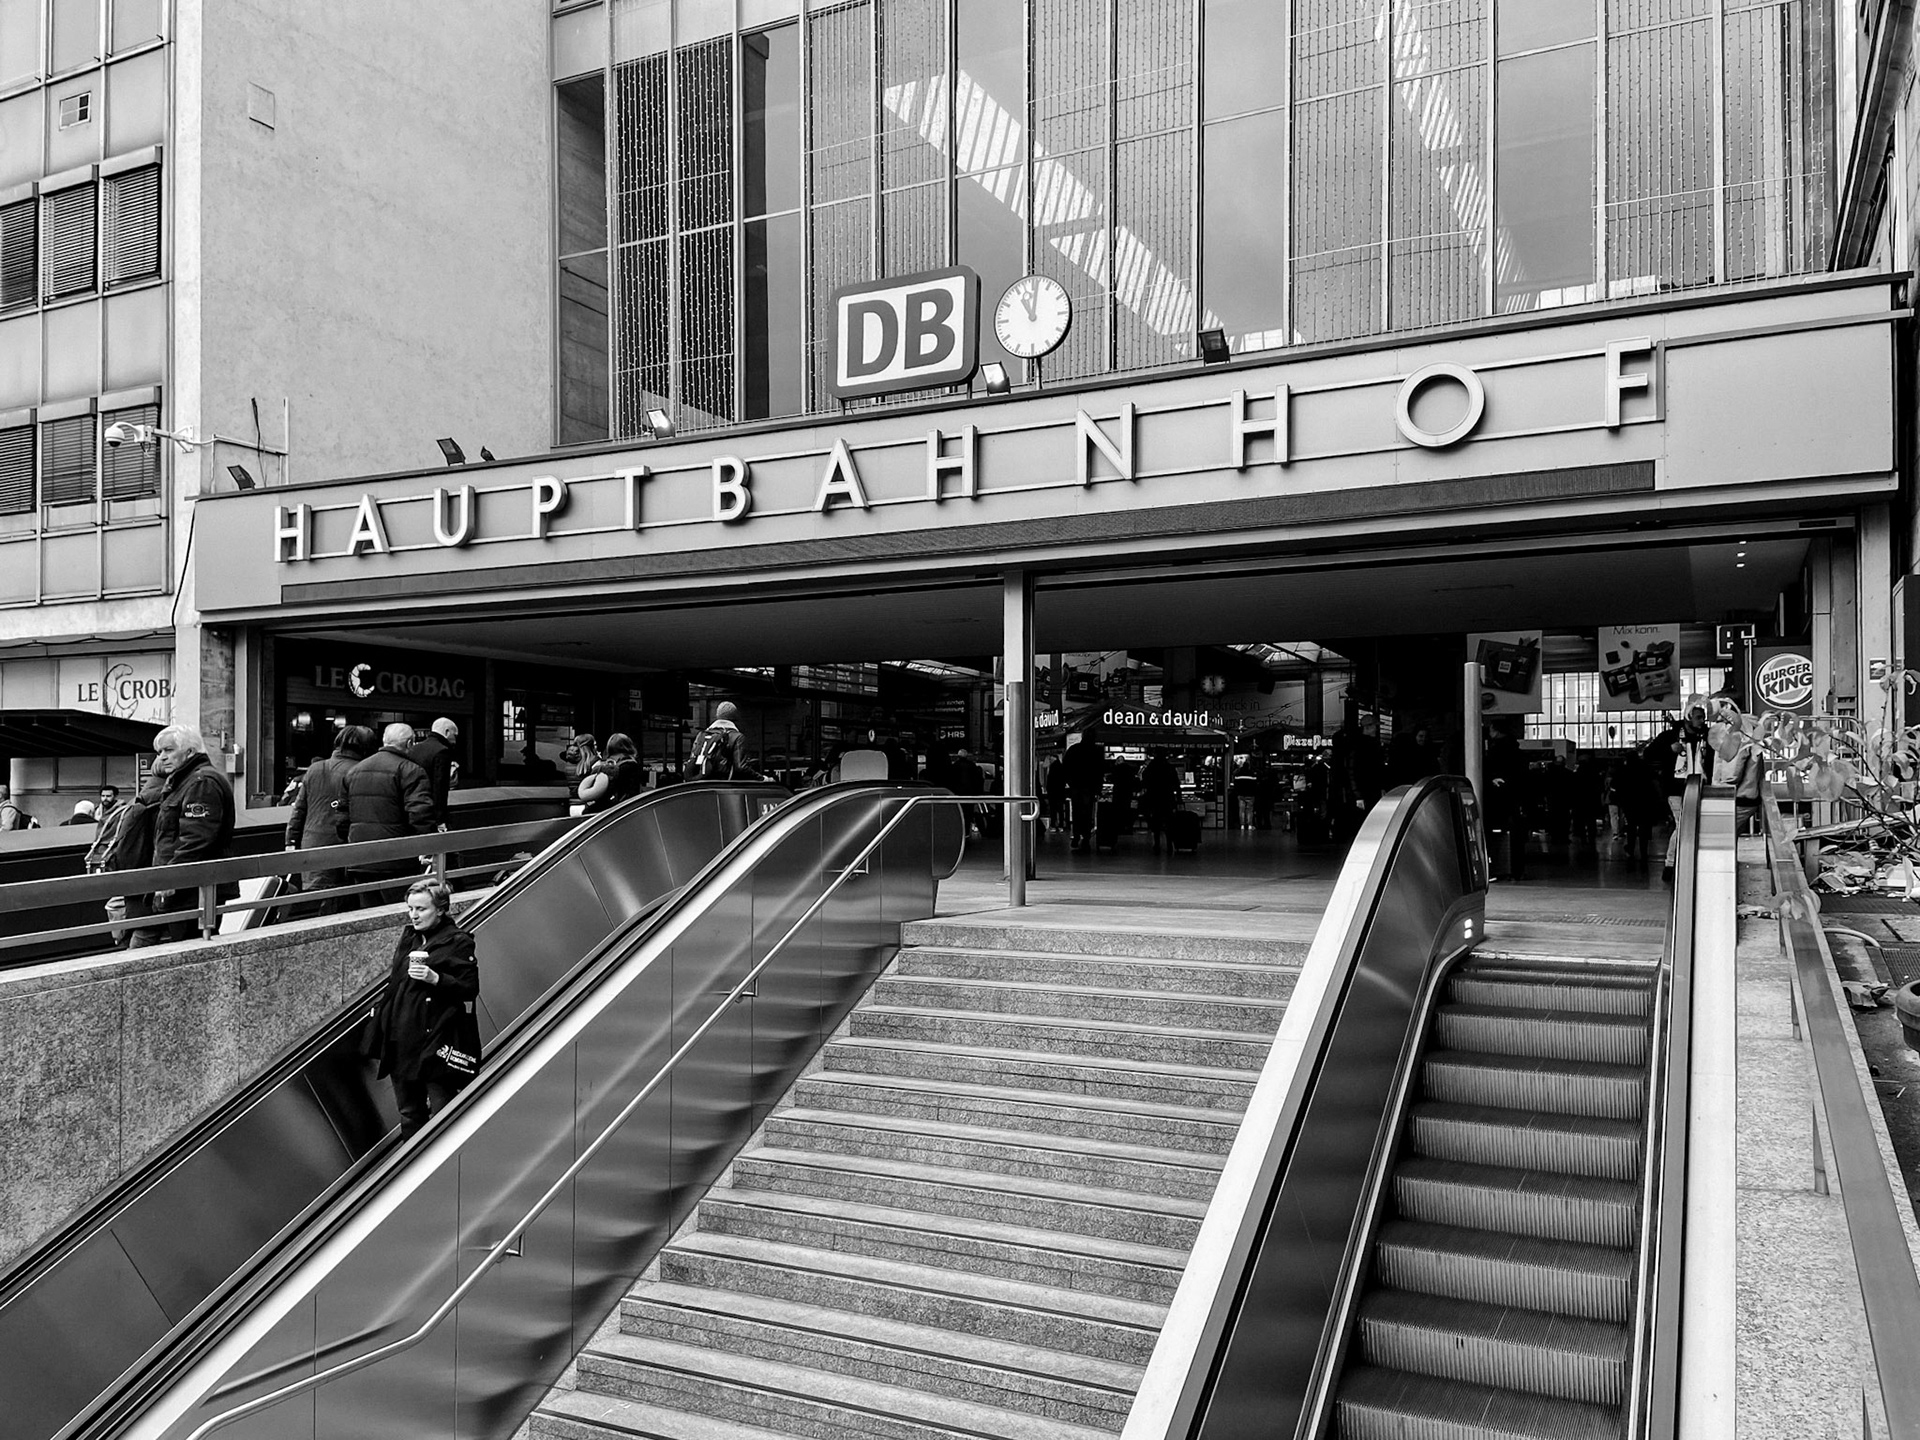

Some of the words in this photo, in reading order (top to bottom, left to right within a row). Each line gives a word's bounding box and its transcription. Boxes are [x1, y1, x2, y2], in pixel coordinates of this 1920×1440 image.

[847, 288, 955, 379] DB
[274, 335, 1652, 563] HAUPTBAHNHOF
[315, 665, 345, 689] LE
[375, 671, 465, 699] CROBAG
[1763, 663, 1810, 685] BURGER
[1765, 673, 1812, 697] KING
[78, 683, 99, 702] LE
[120, 679, 176, 700] CROB
[1039, 710, 1059, 728] david
[1104, 709, 1145, 725] dean
[1150, 712, 1159, 725] &
[1162, 710, 1208, 726] david
